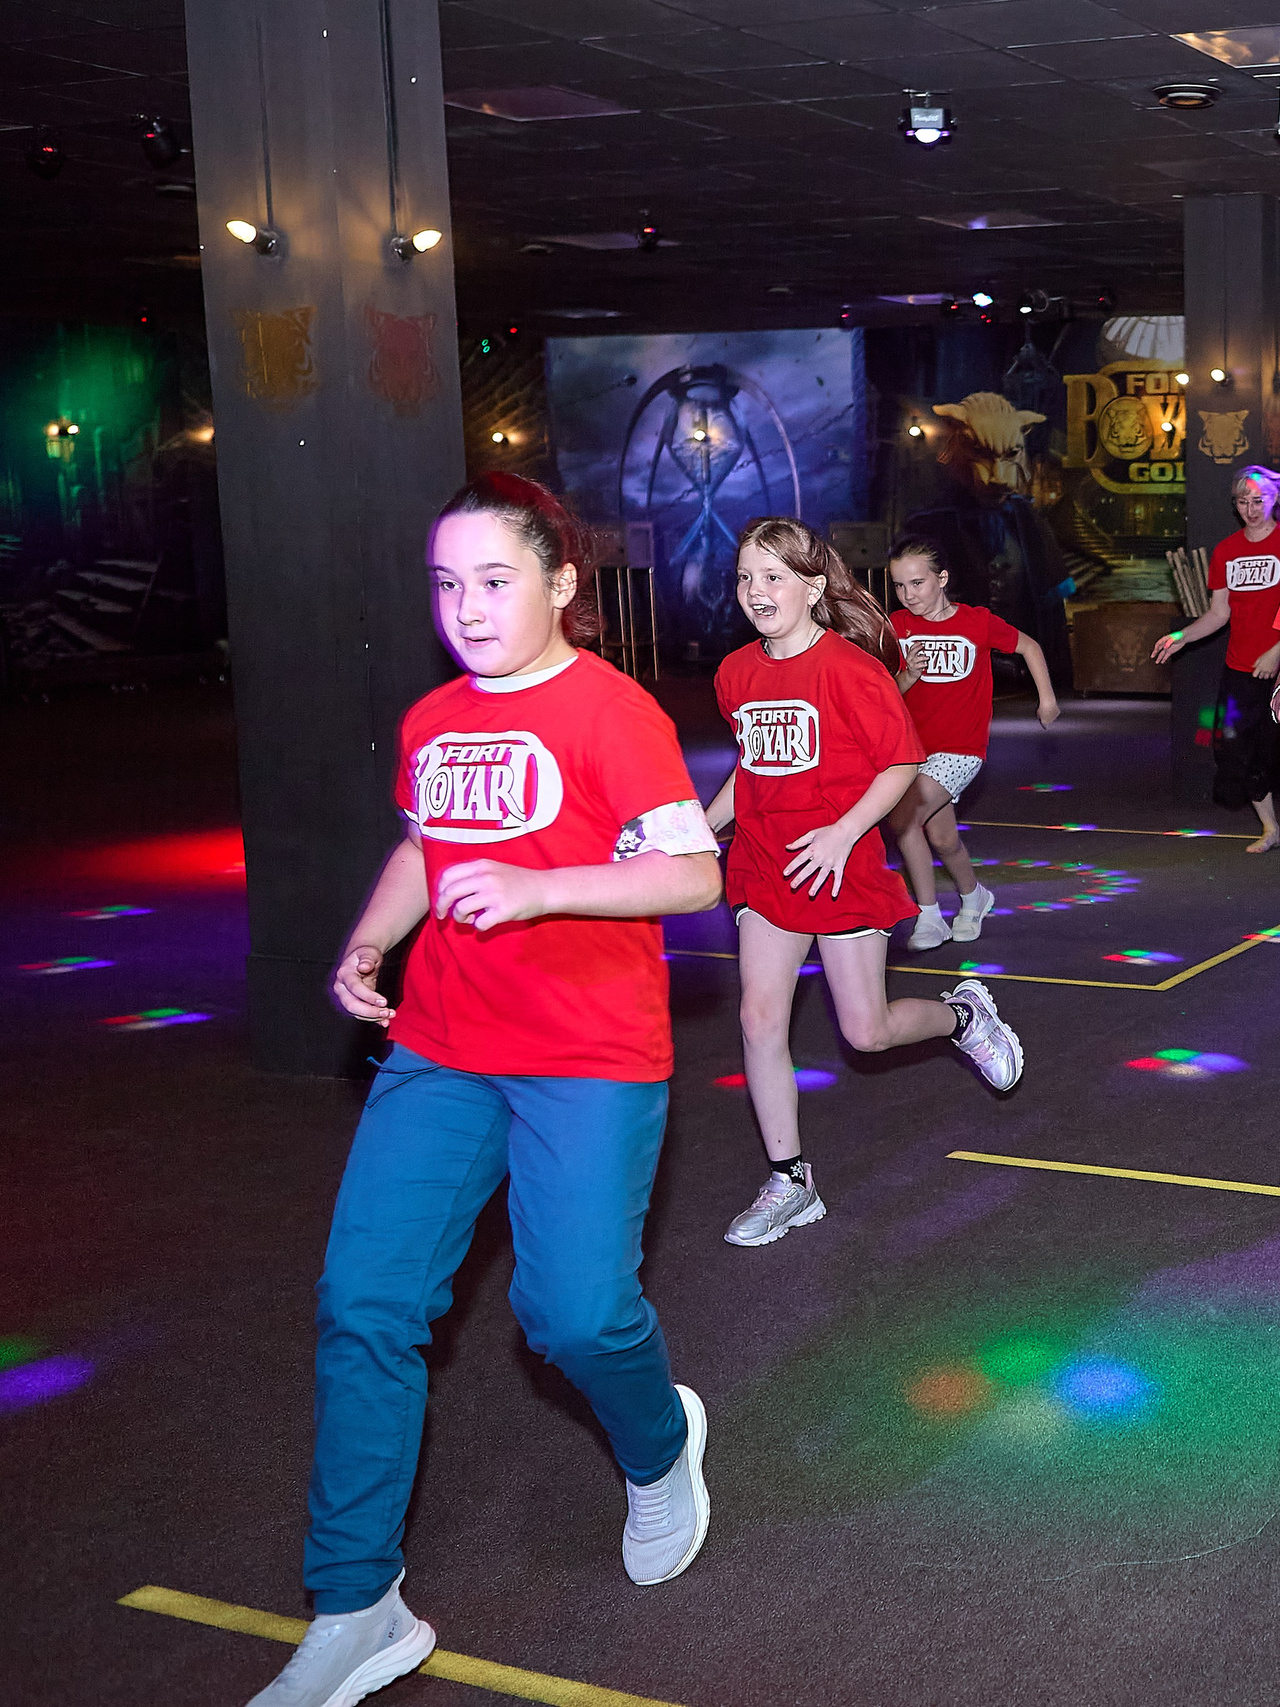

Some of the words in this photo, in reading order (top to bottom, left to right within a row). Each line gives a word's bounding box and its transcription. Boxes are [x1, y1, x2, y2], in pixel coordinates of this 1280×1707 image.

[1128, 462, 1186, 482] GOL
[920, 641, 955, 651] ORT
[752, 710, 796, 724] FORT
[736, 709, 819, 768] BOYARD
[442, 744, 513, 764] FORT
[414, 743, 563, 834] BOYARD
